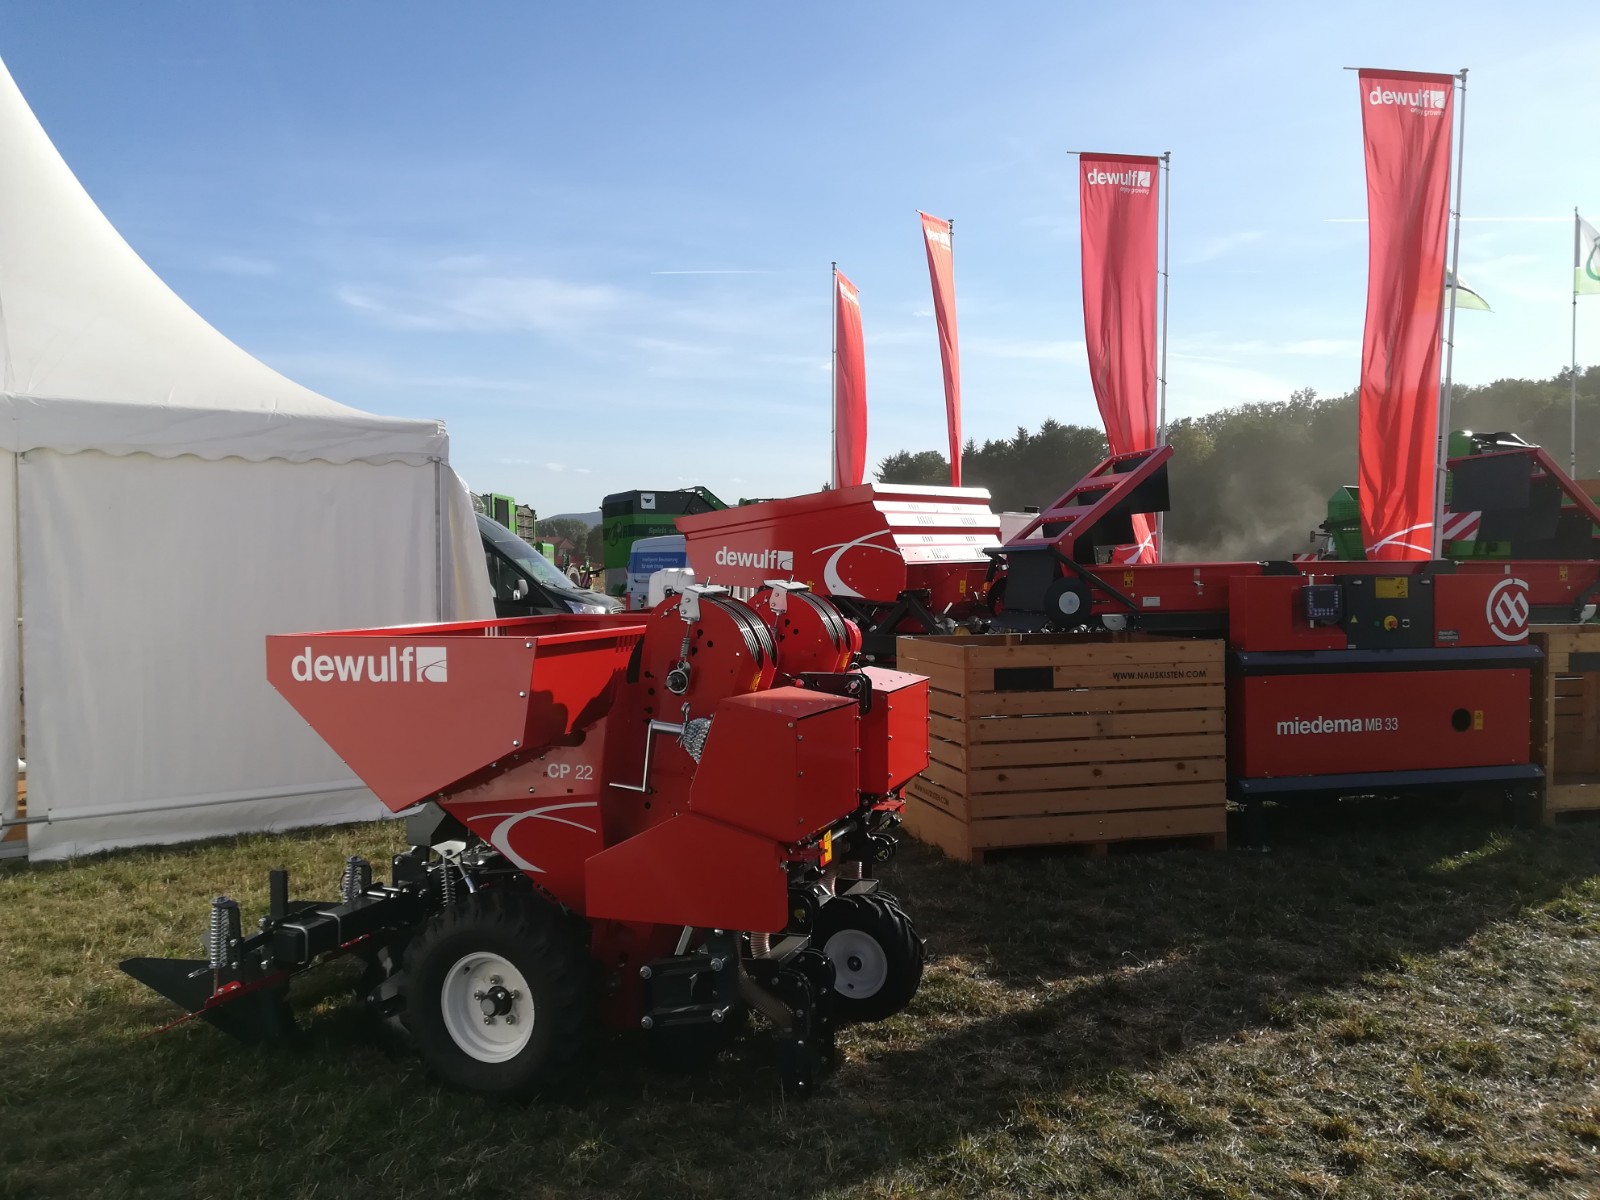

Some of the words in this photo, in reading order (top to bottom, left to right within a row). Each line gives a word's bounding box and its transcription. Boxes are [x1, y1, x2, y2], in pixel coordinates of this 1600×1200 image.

[1369, 86, 1430, 108] dewulf
[1087, 168, 1138, 187] dewulf
[715, 546, 777, 570] dewulf
[291, 646, 413, 682] dewulf
[1112, 670, 1207, 680] WWW.NAUSKISTEN.COM
[1276, 715, 1362, 735] miedema
[1365, 717, 1383, 731] MB
[1385, 717, 1399, 731] 33
[547, 763, 570, 779] CP
[575, 765, 593, 780] 22
